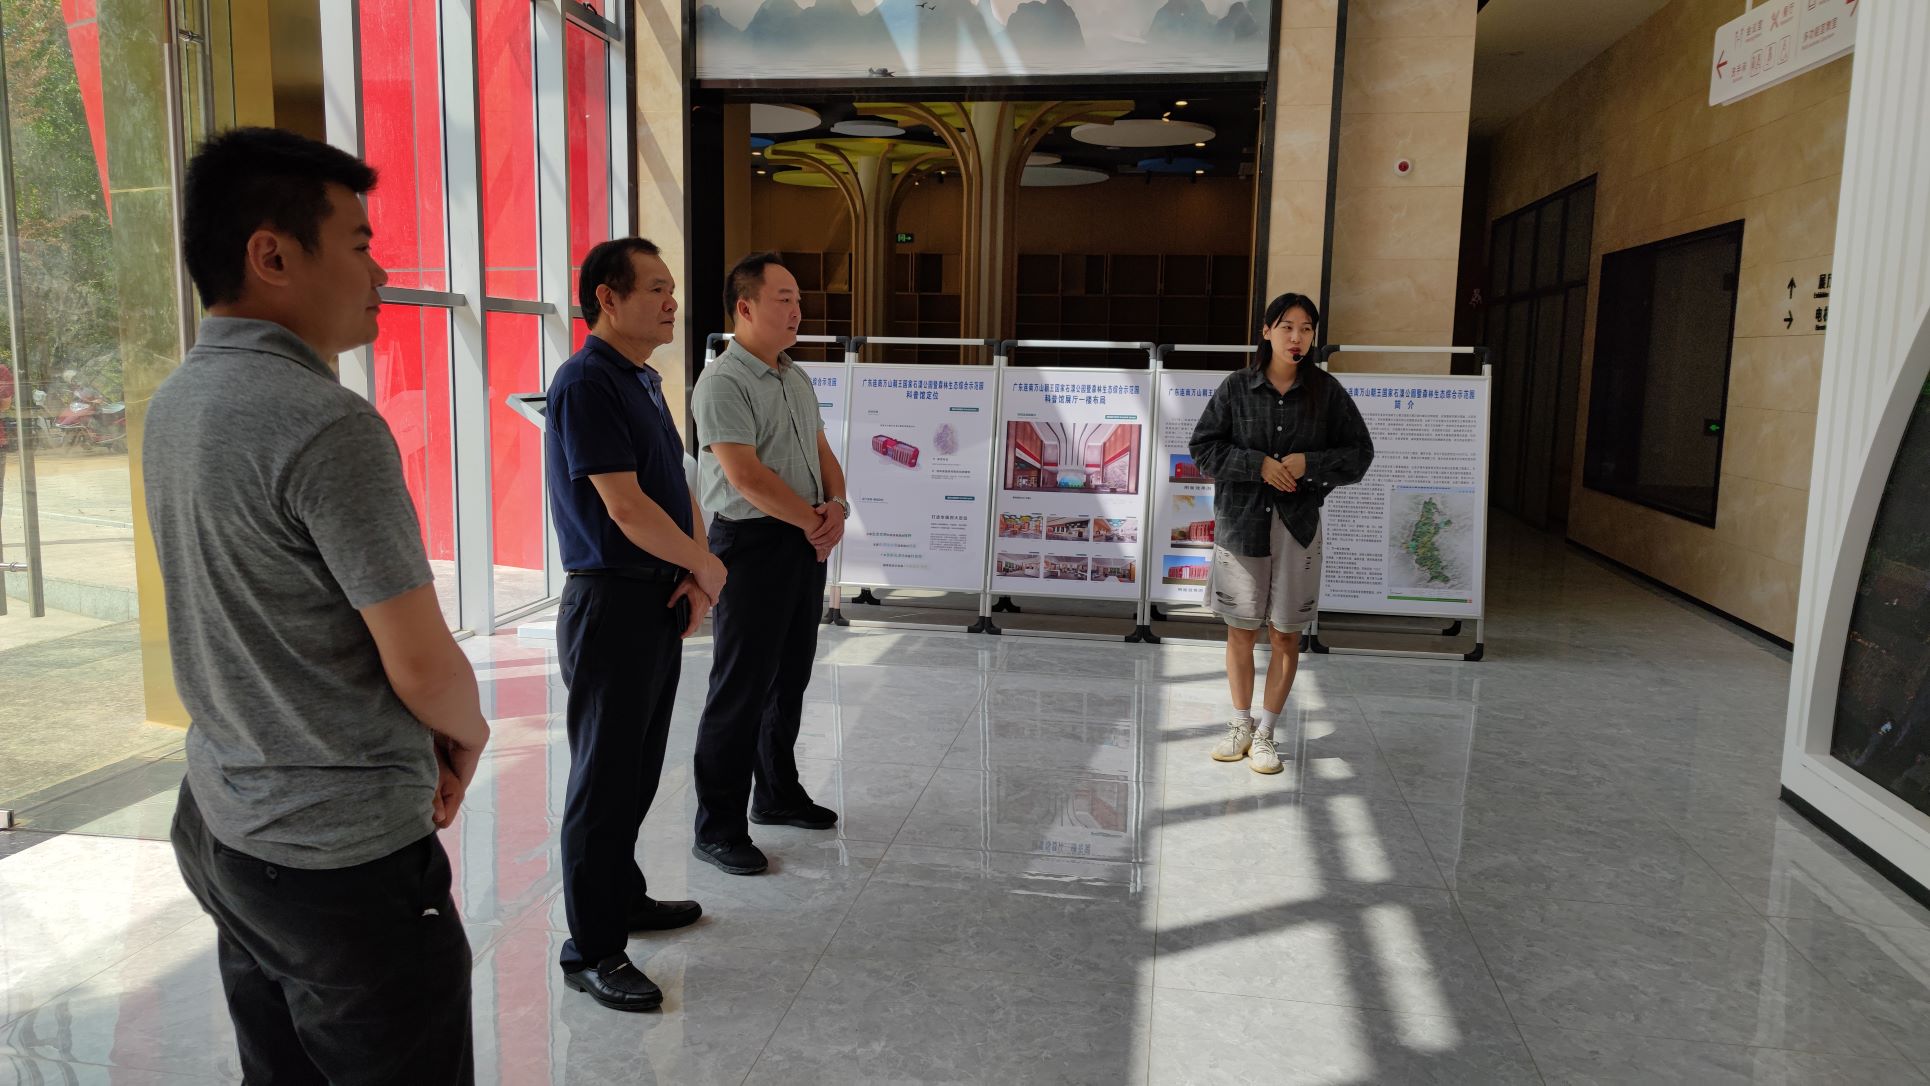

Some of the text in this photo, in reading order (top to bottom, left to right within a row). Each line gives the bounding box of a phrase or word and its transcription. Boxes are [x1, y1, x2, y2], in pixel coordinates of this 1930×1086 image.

[810, 377, 837, 387] 综合示范园
[906, 390, 939, 400] 科普馆定位
[1168, 388, 1217, 397] 广东连南万山朝王
[1345, 387, 1475, 400] 连南万山朝王国家石漠公园暨森林生态综合示范园
[1044, 394, 1106, 405] 科普馆展厅一楼布局
